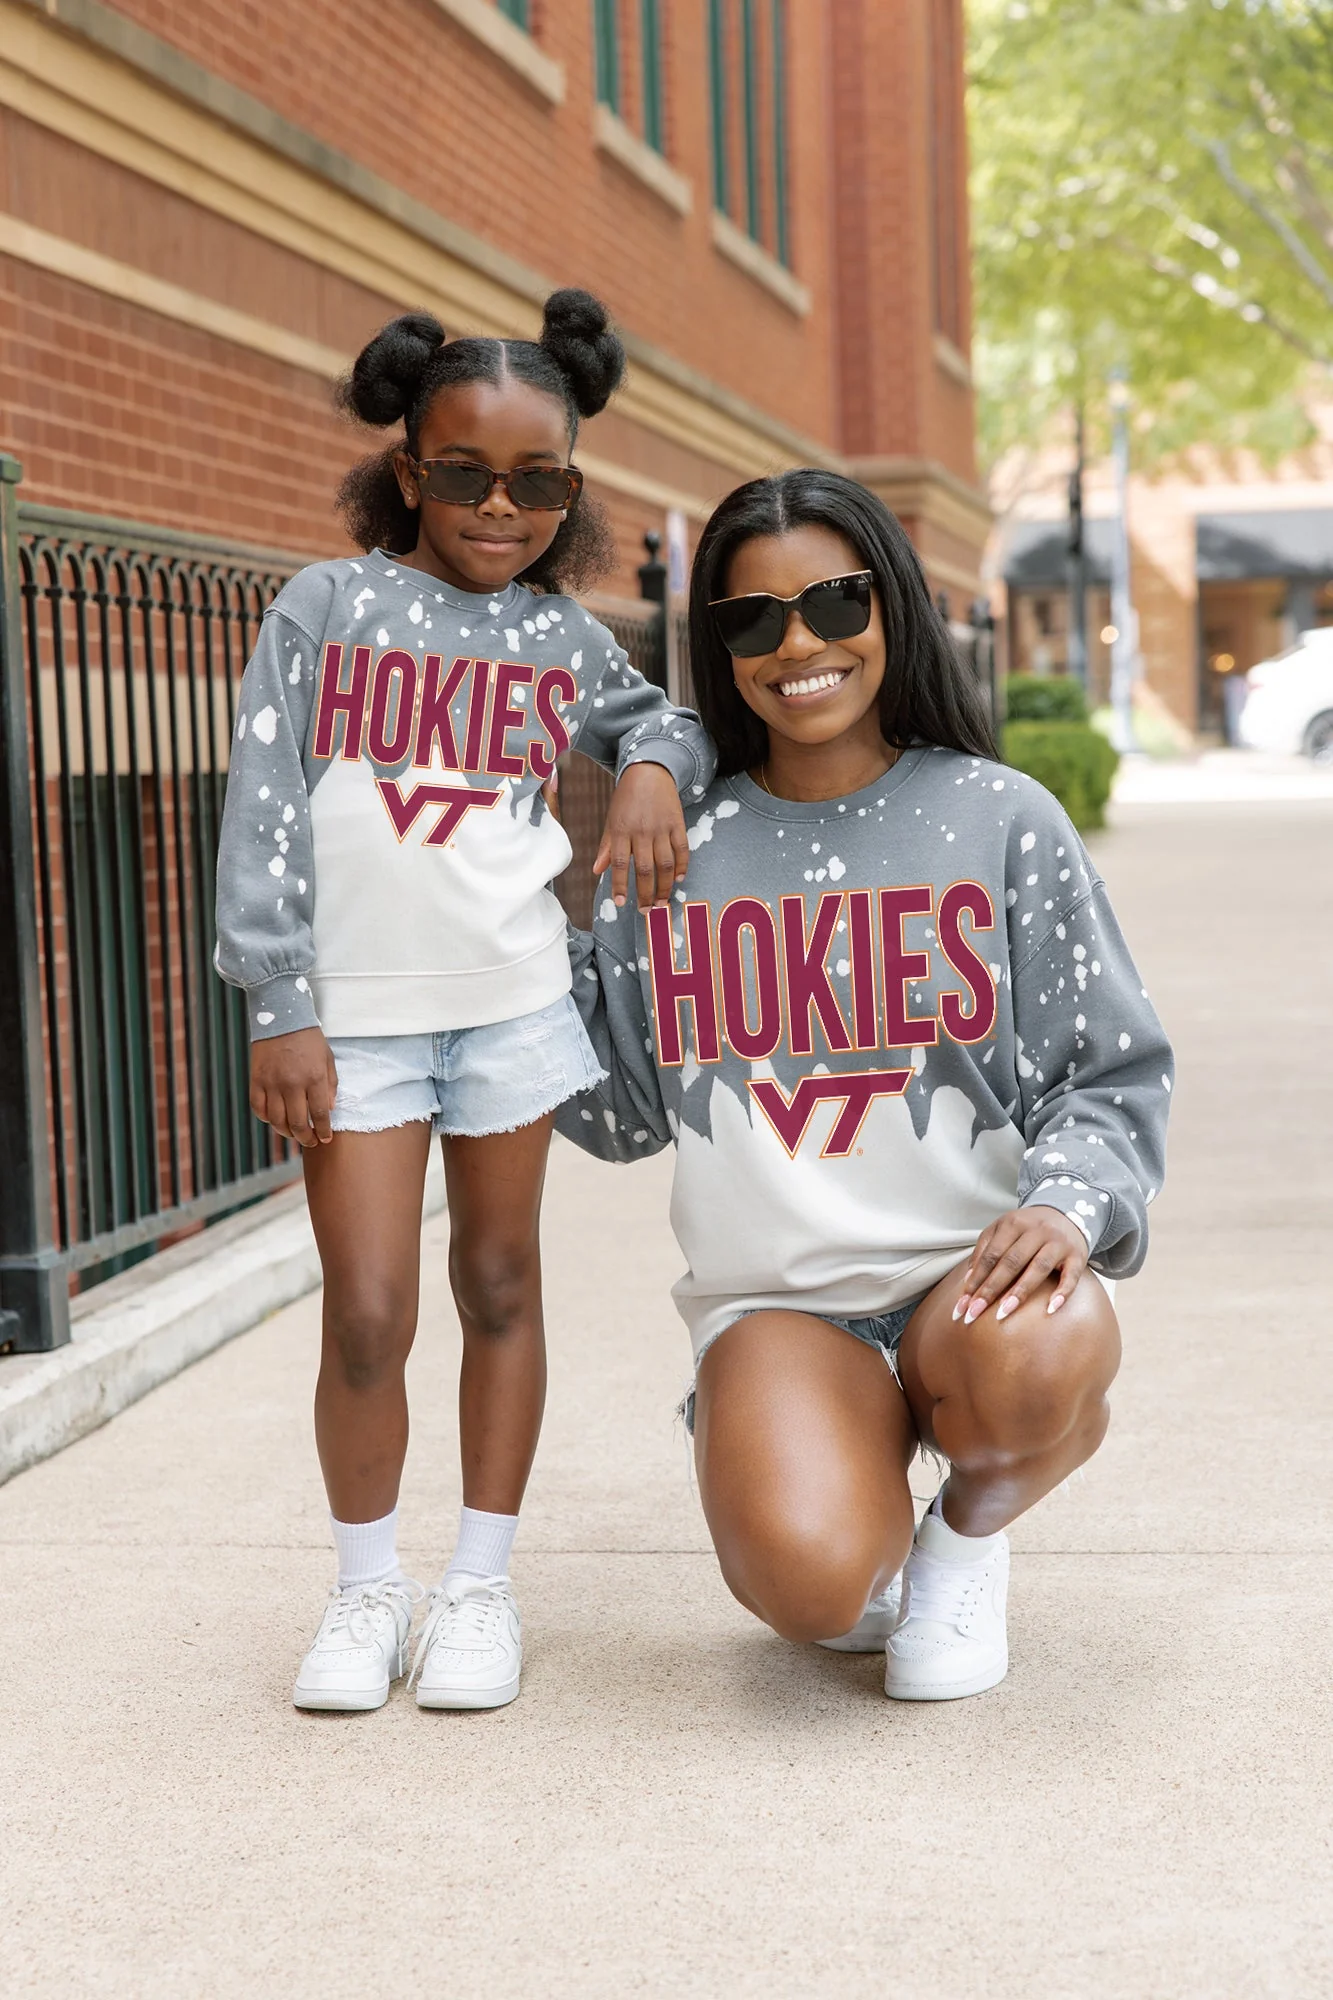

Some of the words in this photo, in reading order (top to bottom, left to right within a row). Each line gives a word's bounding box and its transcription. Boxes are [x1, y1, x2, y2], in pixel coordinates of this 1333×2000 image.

[312, 641, 577, 780] HOKIES
[374, 778, 504, 848] VT
[646, 879, 997, 1067] HOKIES
[744, 1067, 916, 1160] VT
